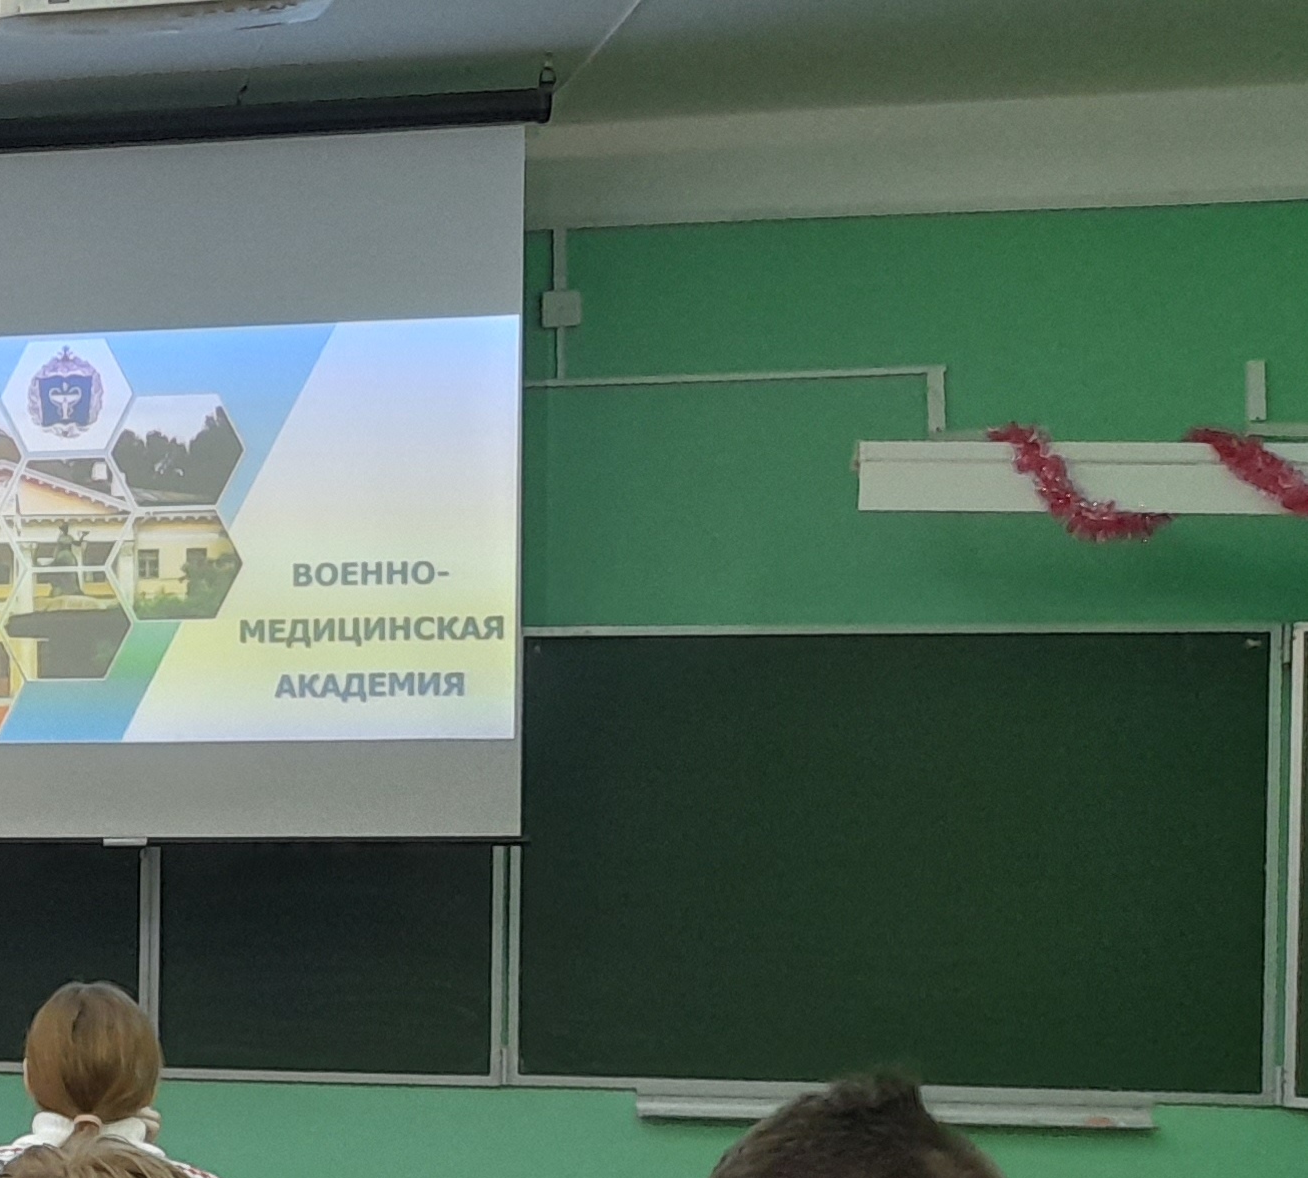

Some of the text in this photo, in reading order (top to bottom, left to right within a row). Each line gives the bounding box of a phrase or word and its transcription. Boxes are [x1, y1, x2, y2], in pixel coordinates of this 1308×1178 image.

[292, 560, 450, 587] ВОЕННО-
[239, 615, 505, 649] МЕДИЦИНСКАЯ
[274, 672, 466, 703] АКАДЕМИЯ
